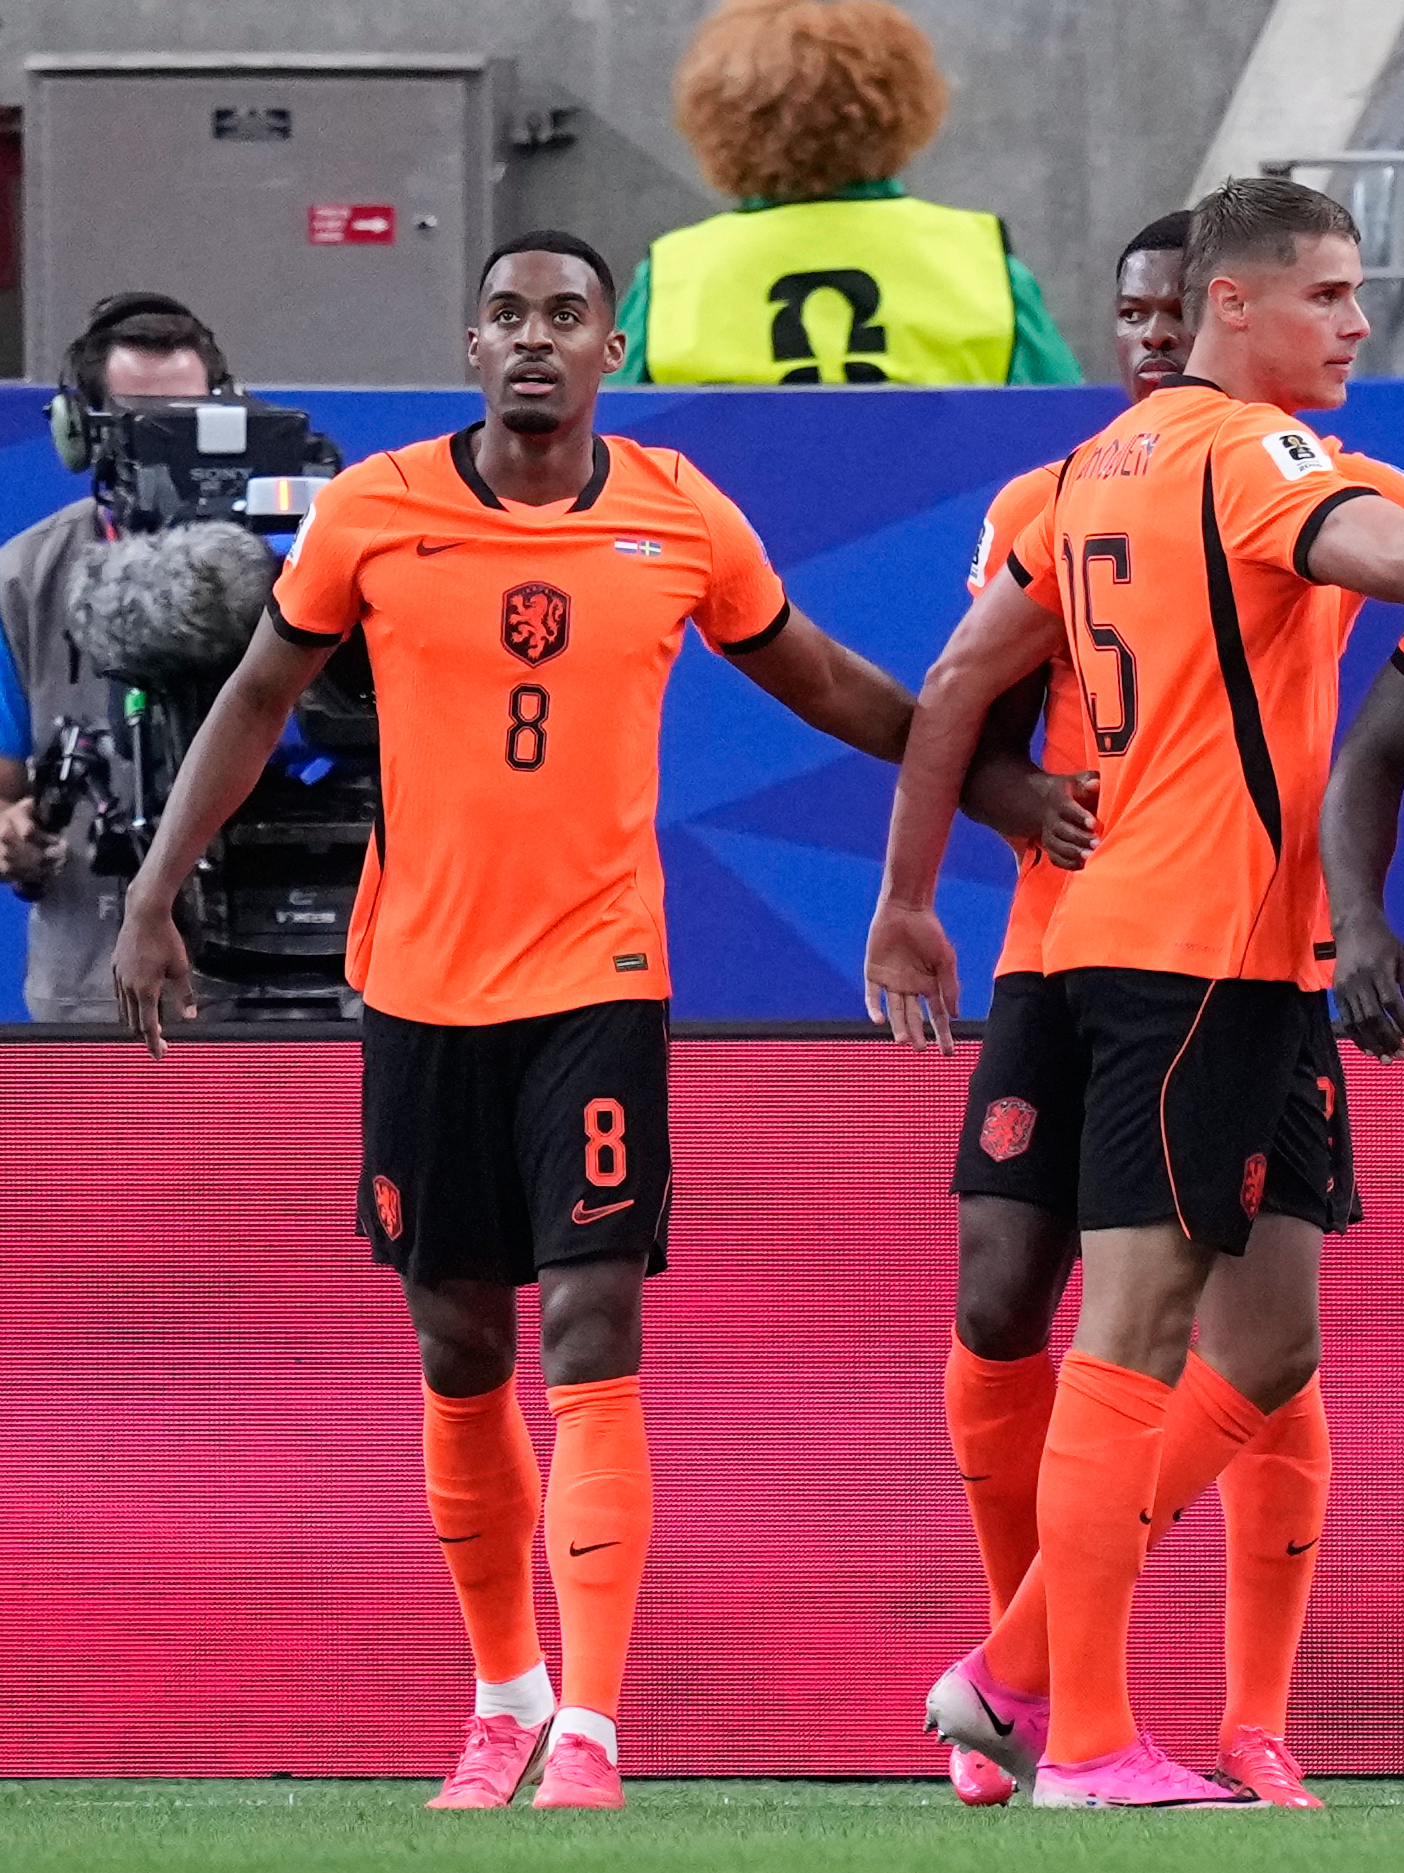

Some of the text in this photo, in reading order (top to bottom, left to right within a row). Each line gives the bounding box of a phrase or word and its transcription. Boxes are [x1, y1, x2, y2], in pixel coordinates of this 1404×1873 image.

[1061, 532, 1139, 757] 15
[505, 683, 550, 773] 8
[584, 1098, 627, 1187] 8
